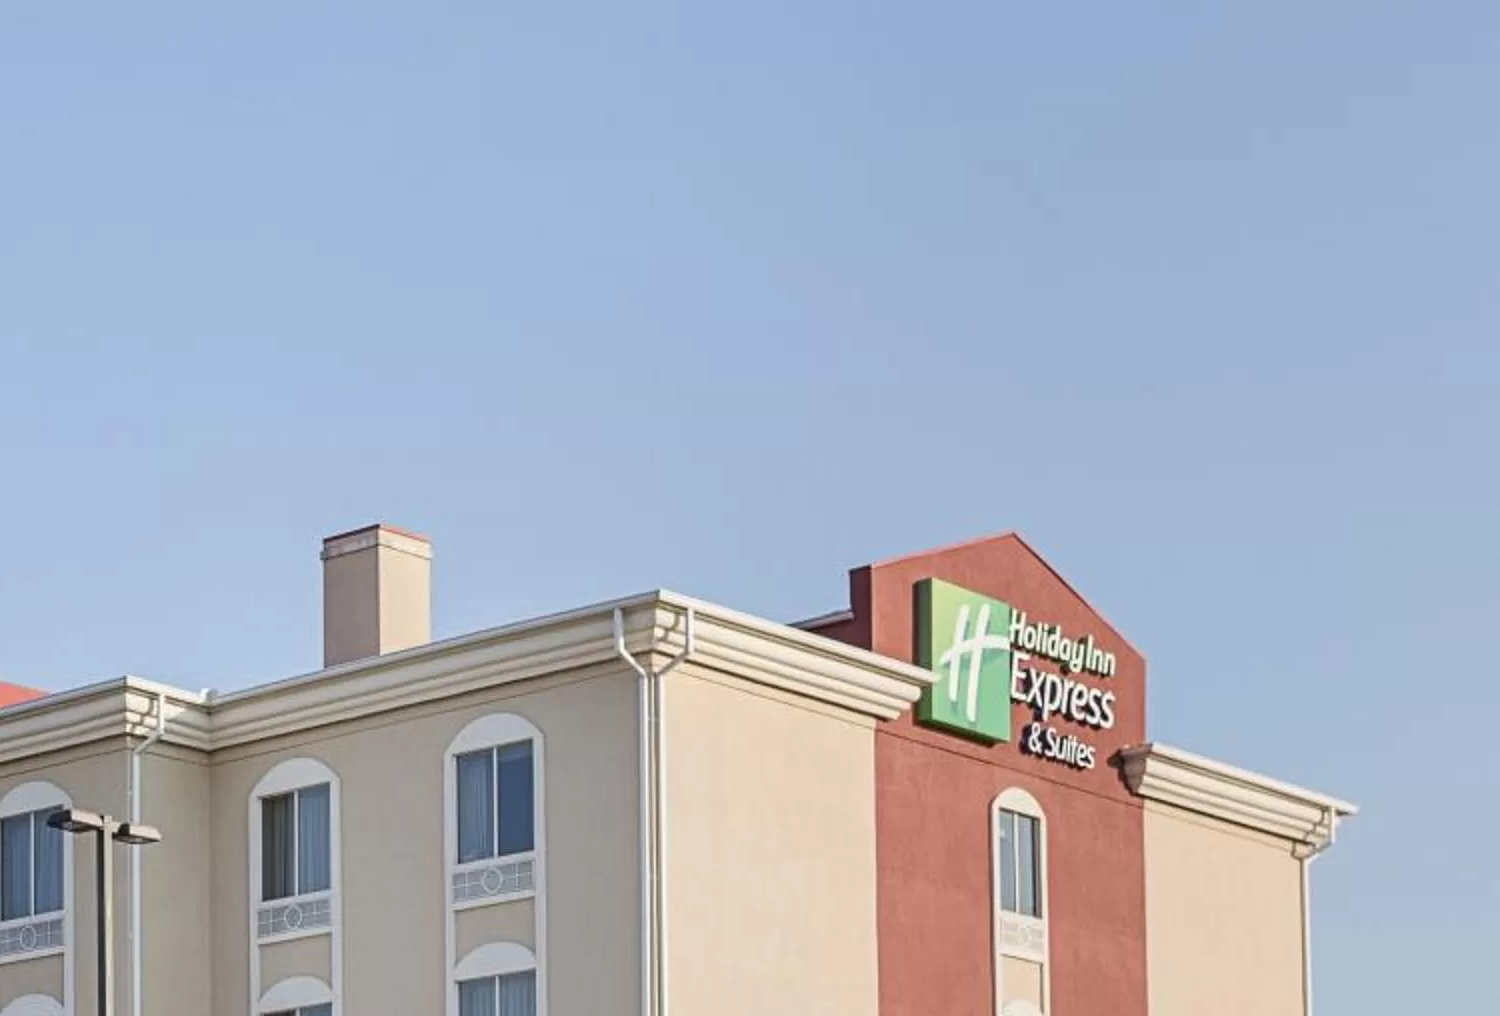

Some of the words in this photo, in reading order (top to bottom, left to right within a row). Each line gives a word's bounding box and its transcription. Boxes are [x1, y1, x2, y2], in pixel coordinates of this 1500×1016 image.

[1009, 608, 1085, 673] Holiday
[1010, 650, 1116, 730] Express
[1028, 722, 1043, 755] &
[1044, 727, 1096, 770] Suites
